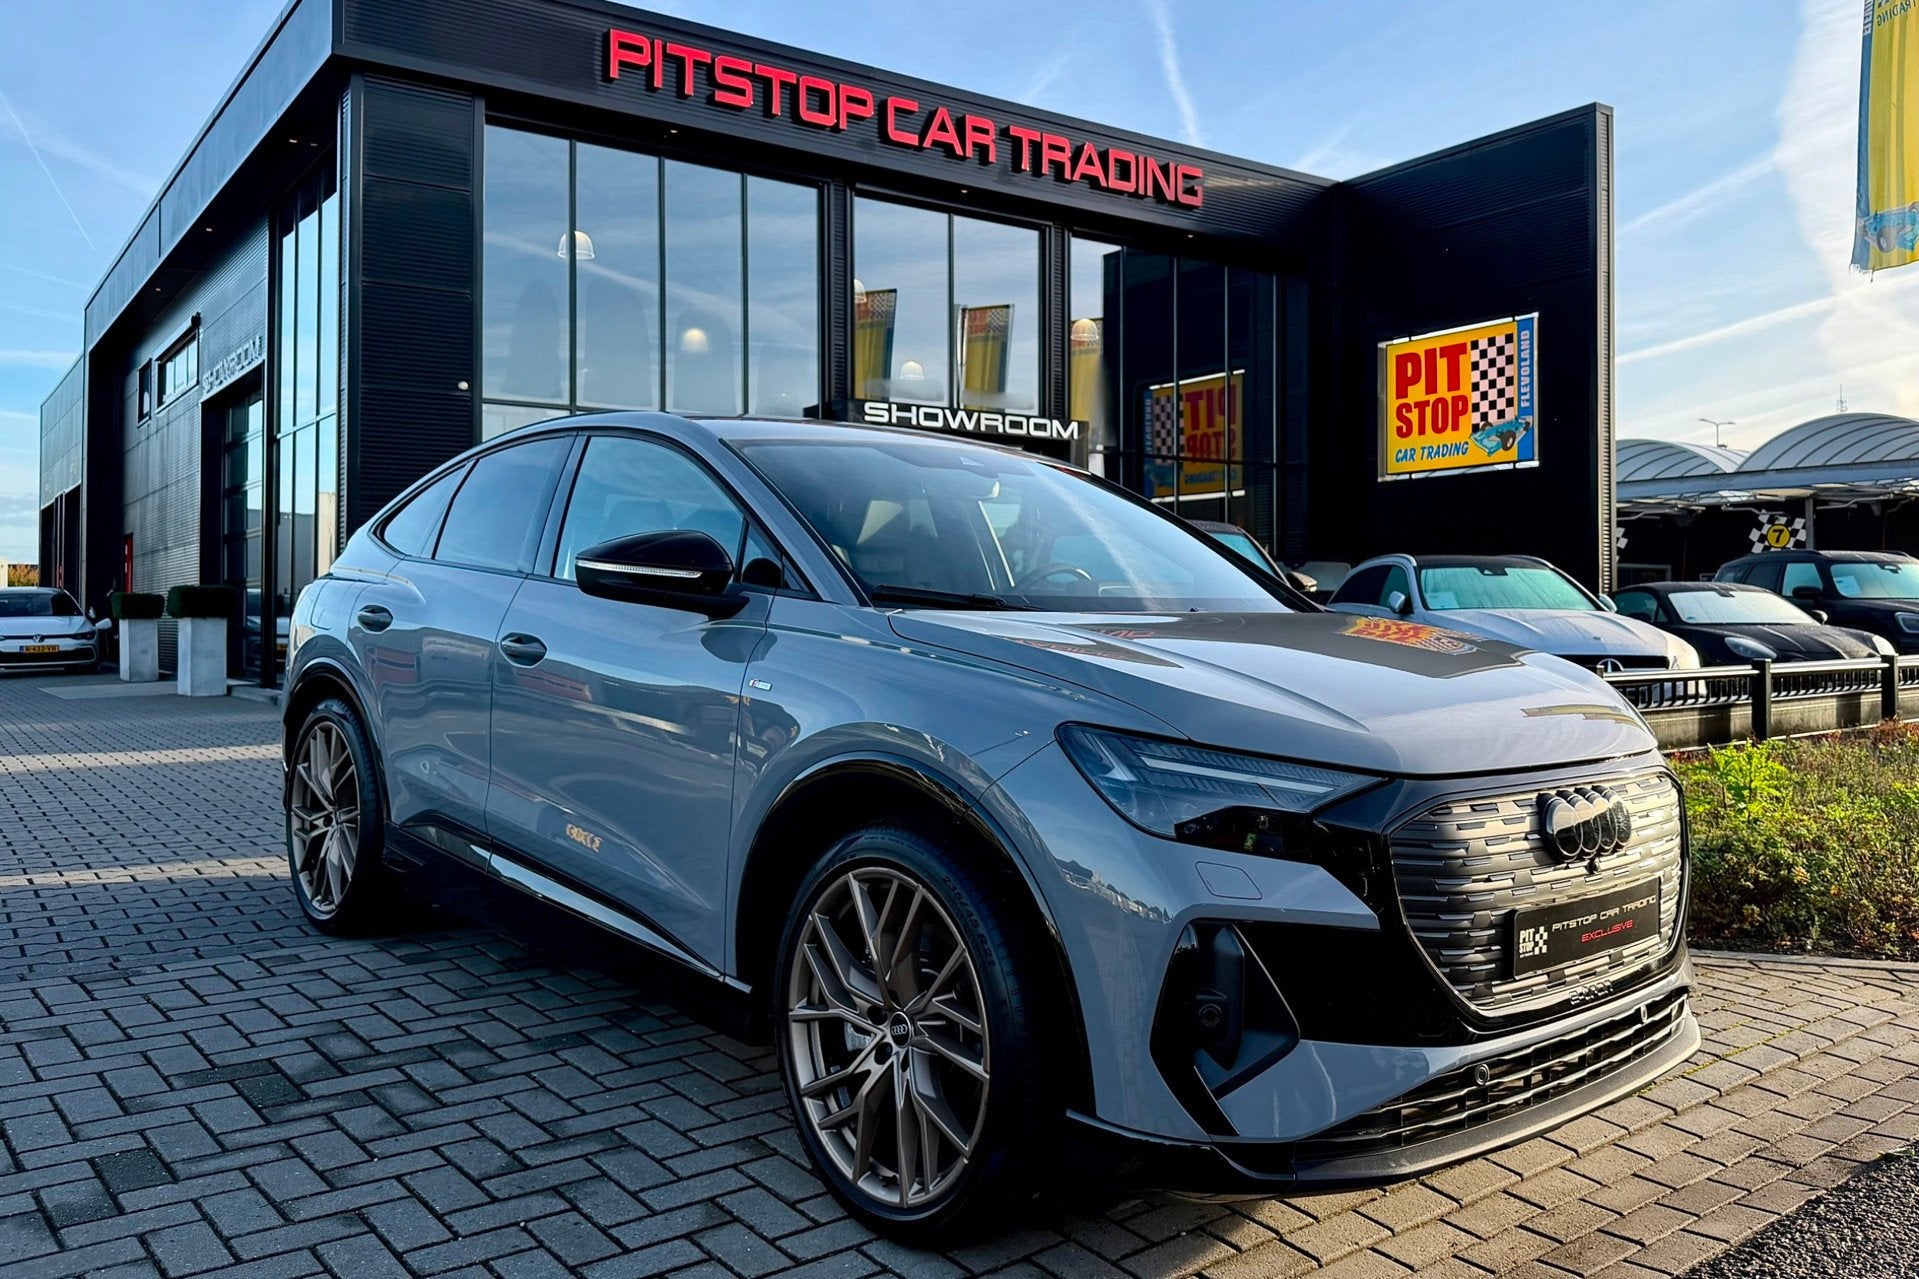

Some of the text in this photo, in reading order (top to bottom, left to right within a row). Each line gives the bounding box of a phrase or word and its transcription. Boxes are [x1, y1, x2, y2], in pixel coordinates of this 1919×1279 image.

[608, 28, 1203, 207] PITSTOP CAR TRADING
[1395, 342, 1468, 400] PIT
[1520, 330, 1531, 409] FLEVOLAND
[863, 402, 1079, 440] SHOWROOM
[1395, 394, 1469, 439] STOP
[1395, 441, 1469, 463] CAR TRADING
[1772, 528, 1785, 544] 7
[1552, 895, 1657, 932] PITSTOP CAR TRADING
[1581, 920, 1634, 942] EXCLUSIVE
[1519, 928, 1535, 944] PIT
[1519, 941, 1535, 954] STOP
